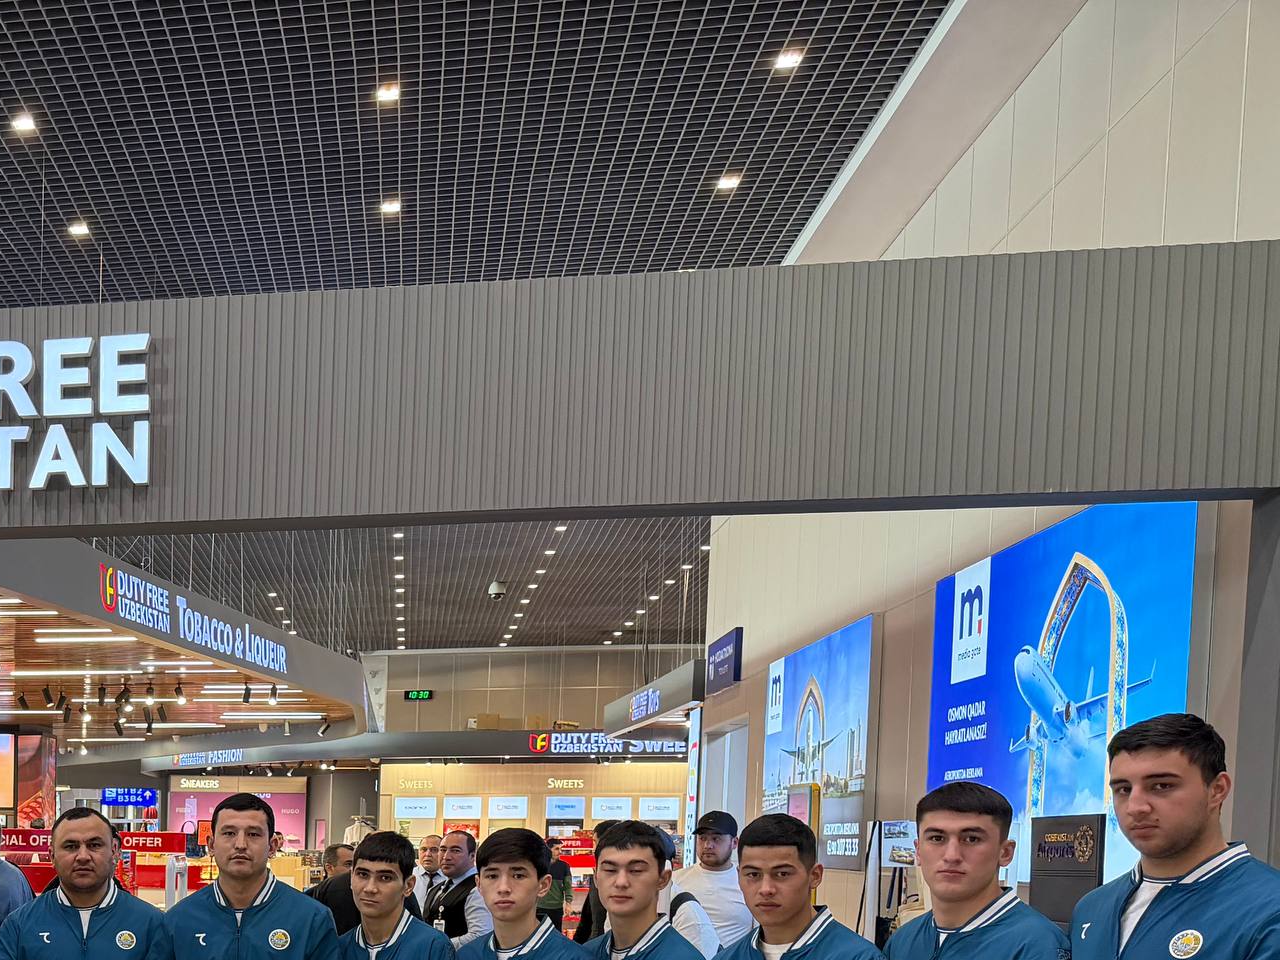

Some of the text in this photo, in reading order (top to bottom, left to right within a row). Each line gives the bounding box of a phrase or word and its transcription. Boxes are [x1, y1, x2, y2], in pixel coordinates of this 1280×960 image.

[117, 569, 170, 613] DUTY FREE
[118, 596, 170, 634] UZBEKISTAN
[176, 595, 288, 674] TOBACCO & LIQUEUR
[551, 733, 591, 744] DUTY
[551, 740, 687, 753] UZBEKISTAN SWEE
[208, 748, 243, 764] FASHION
[180, 778, 219, 789] SNEAKERS
[400, 778, 433, 789] SWEETS
[547, 777, 584, 789] SWEETS
[0, 834, 52, 846] CIAL OFF
[123, 836, 162, 848] OFFER
